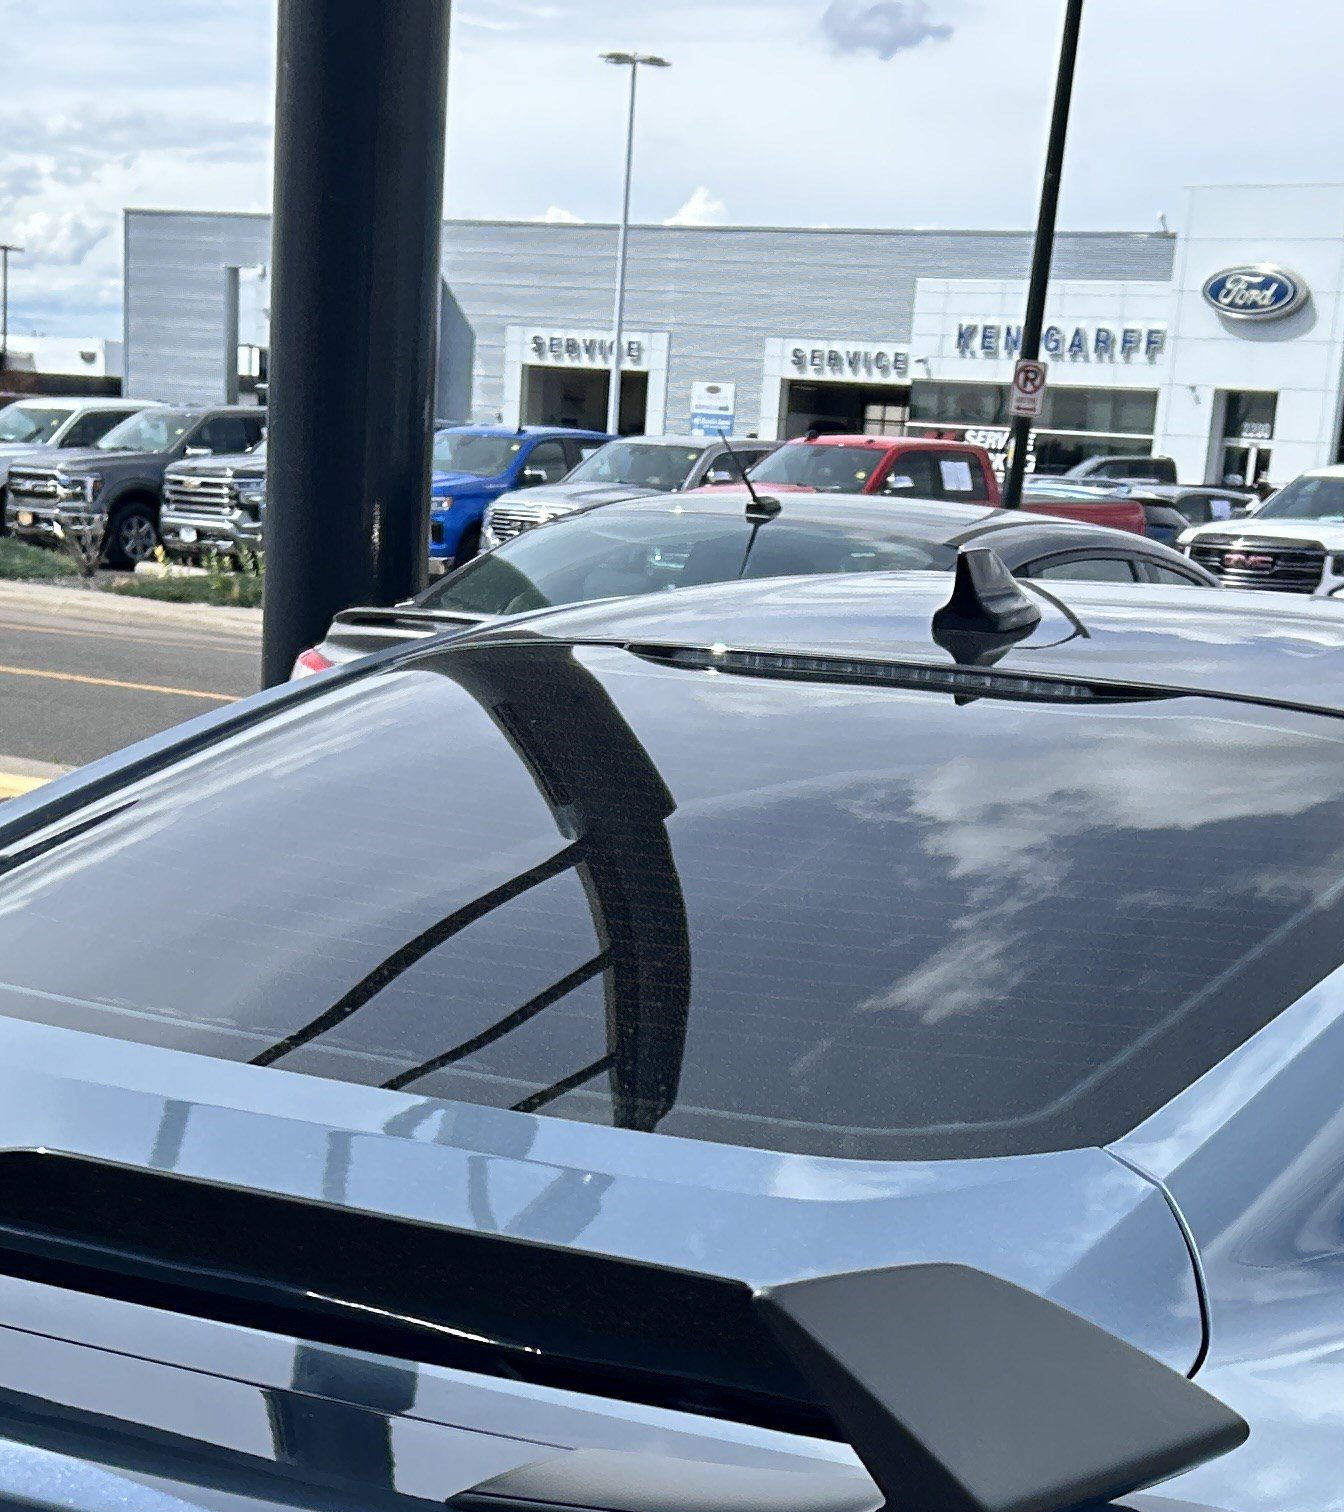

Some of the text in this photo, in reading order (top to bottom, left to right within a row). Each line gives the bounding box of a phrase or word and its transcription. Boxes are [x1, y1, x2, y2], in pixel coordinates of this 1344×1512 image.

[1218, 274, 1279, 306] Ford
[956, 323, 1166, 358] KEN GARFF
[791, 348, 909, 373] SERVICE
[964, 429, 1037, 452] SERVE
